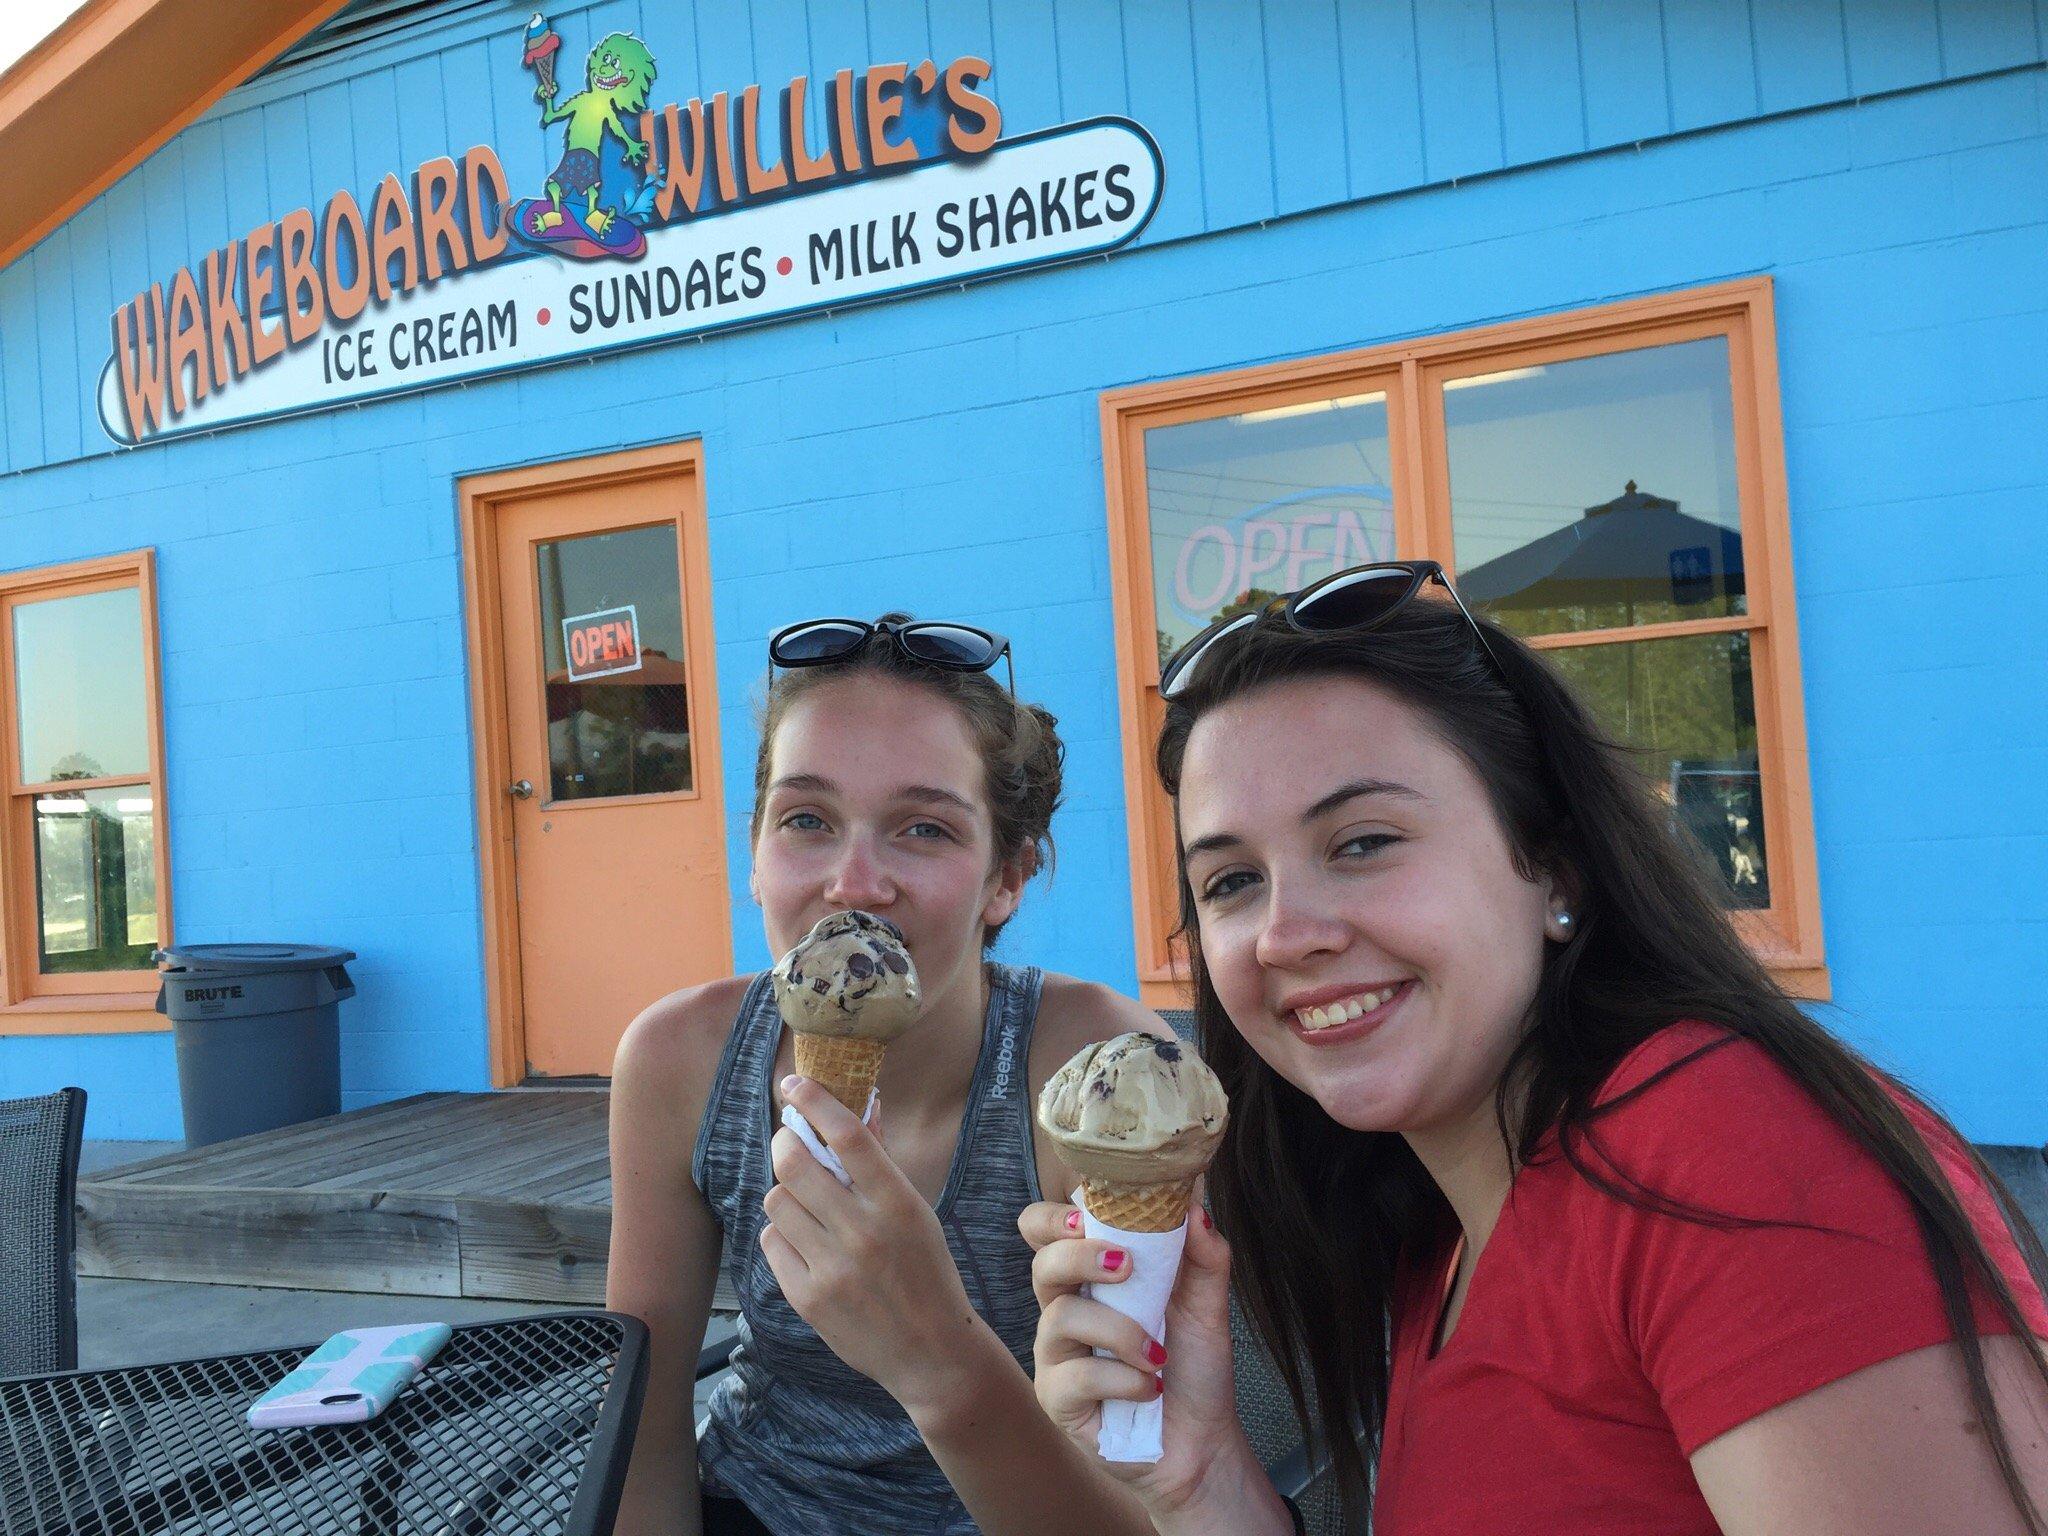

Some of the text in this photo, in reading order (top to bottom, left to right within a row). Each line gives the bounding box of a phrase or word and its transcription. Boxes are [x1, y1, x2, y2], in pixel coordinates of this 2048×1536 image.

[114, 56, 1002, 442] WAKEBOARD WILLIE'S
[322, 163, 1136, 384] ICE CREAM SUNDAES MILK SHAKES
[1174, 505, 1395, 612] OPEN
[570, 620, 635, 667] OPEN
[184, 985, 243, 1002] BRUTE
[991, 1025, 1017, 1100] Reebok
